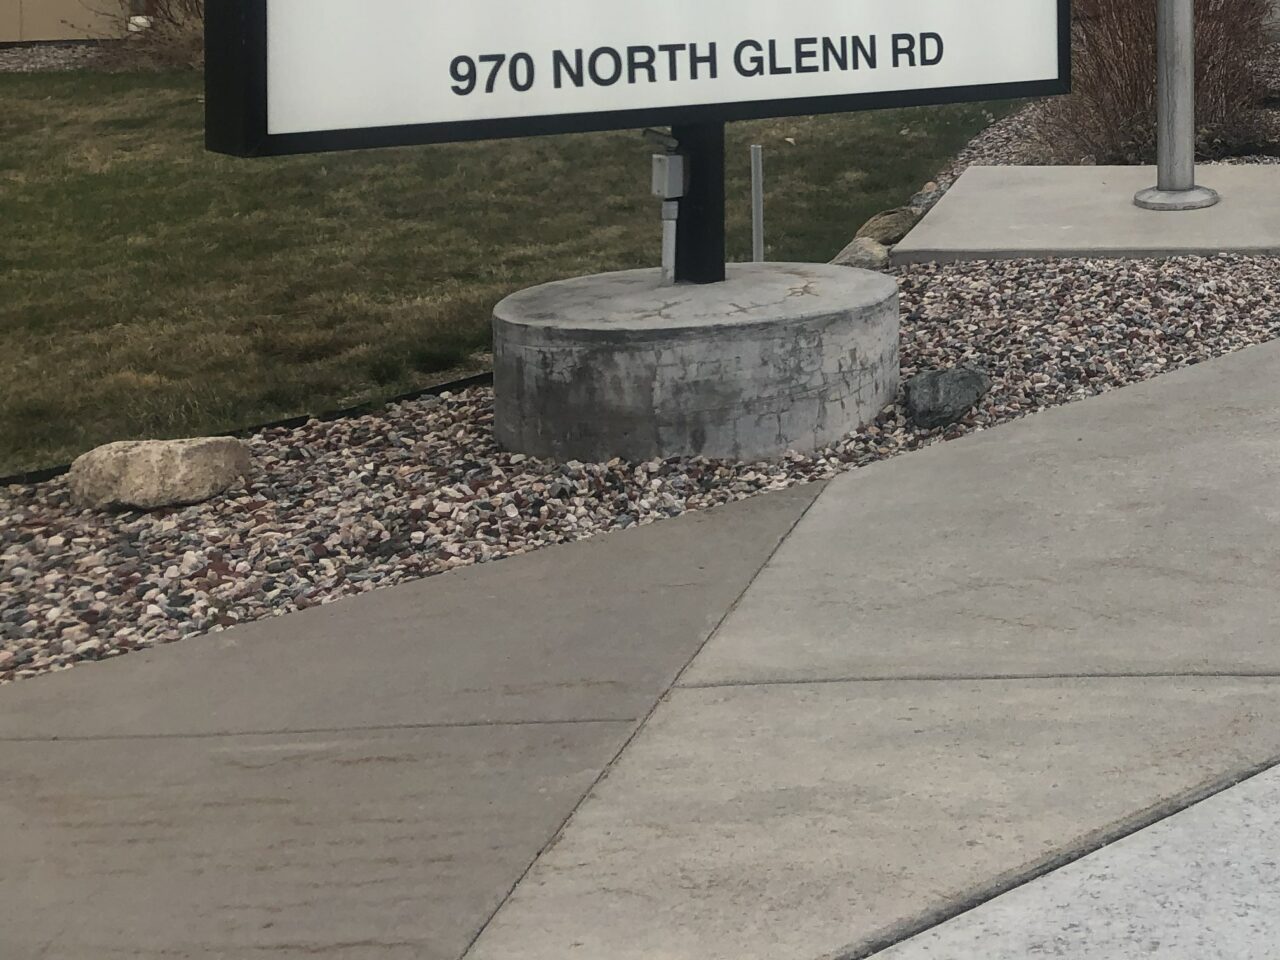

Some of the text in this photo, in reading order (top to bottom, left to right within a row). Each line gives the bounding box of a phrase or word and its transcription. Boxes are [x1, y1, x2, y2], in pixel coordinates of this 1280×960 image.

[450, 32, 943, 95] 970 NORTH GLENN RD
